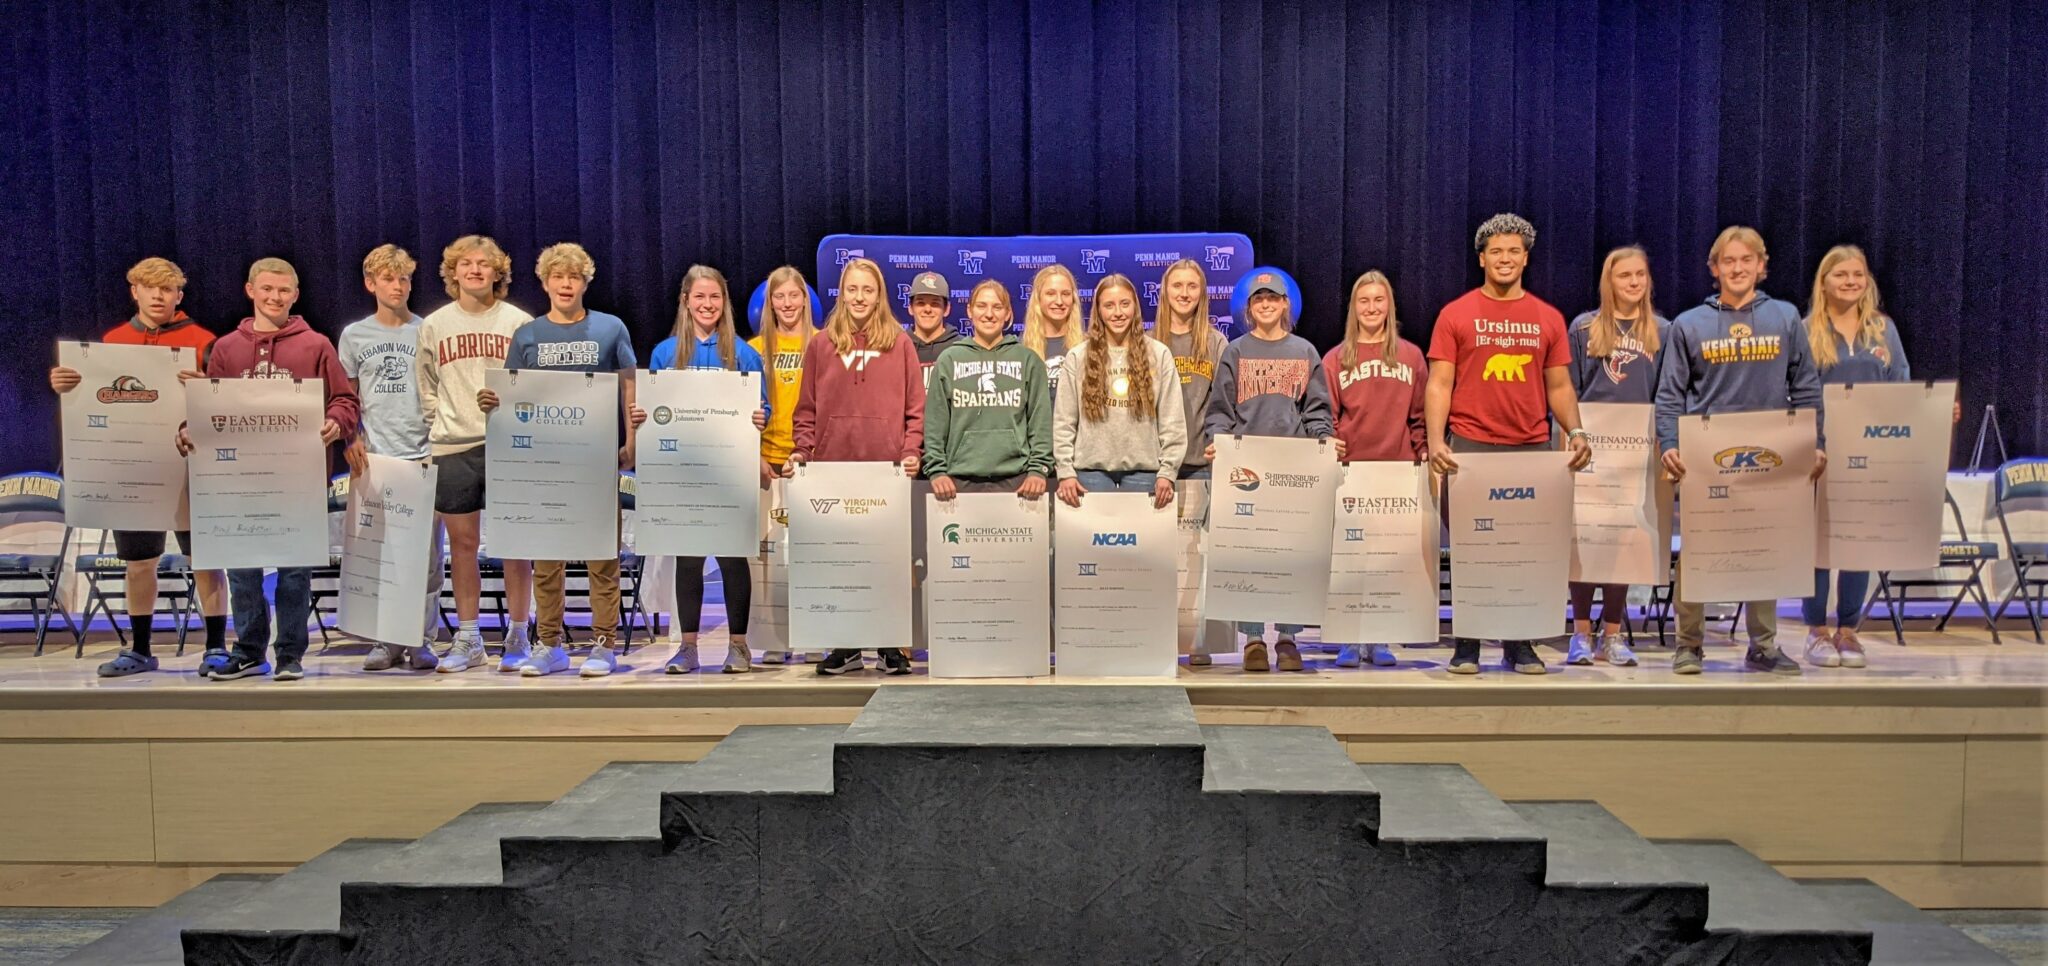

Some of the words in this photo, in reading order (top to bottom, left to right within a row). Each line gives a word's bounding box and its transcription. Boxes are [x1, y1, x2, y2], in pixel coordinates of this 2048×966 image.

[889, 254, 908, 263] PENN
[909, 254, 934, 263] MANOR
[1011, 255, 1030, 264] PENN
[1031, 255, 1057, 263] MANOR
[1135, 253, 1154, 262] PENN
[1155, 252, 1180, 261] MANOR
[951, 289, 970, 298] PENN
[1218, 286, 1235, 294] MAN
[1474, 318, 1541, 335] Ursinus
[357, 342, 395, 364] LEBANON
[395, 342, 417, 359] VALL
[538, 341, 599, 354] HOOD
[1701, 338, 1737, 360] KENT
[1740, 335, 1780, 355] STATE
[538, 352, 599, 366] COLLEGE
[840, 350, 881, 371] VT
[953, 361, 994, 381] MICHIGAN
[995, 361, 1022, 381] STATE
[1339, 359, 1413, 391] EASTERN
[374, 383, 407, 393] COLLEGE
[952, 388, 1021, 408] SPARTANS
[536, 405, 586, 419] HOOD
[673, 407, 701, 416] University
[702, 407, 709, 415] of
[710, 408, 739, 416] Pittsburgh
[229, 414, 299, 426] EASTERN
[536, 418, 583, 426] COLLEGE
[673, 415, 705, 423] Johnstown
[1863, 426, 1911, 438] NCAA
[1264, 472, 1320, 482] SHIPPENSBURG
[2005, 464, 2034, 487] PENN
[0, 477, 22, 497] ENN
[22, 477, 61, 500] MANOR
[1268, 479, 1314, 489] UNIVERSITY
[1488, 487, 1536, 500] NCAA
[361, 496, 382, 509] Lebanon
[395, 503, 415, 517] College
[809, 498, 840, 514] VT
[843, 498, 887, 507] VIRGINIA
[1358, 497, 1418, 508] EASTERN
[843, 506, 869, 515] TECH
[965, 527, 1009, 535] MICHIGAN
[1010, 527, 1033, 535] STATE
[1092, 533, 1137, 546] NCAA
[95, 557, 128, 567] COME
